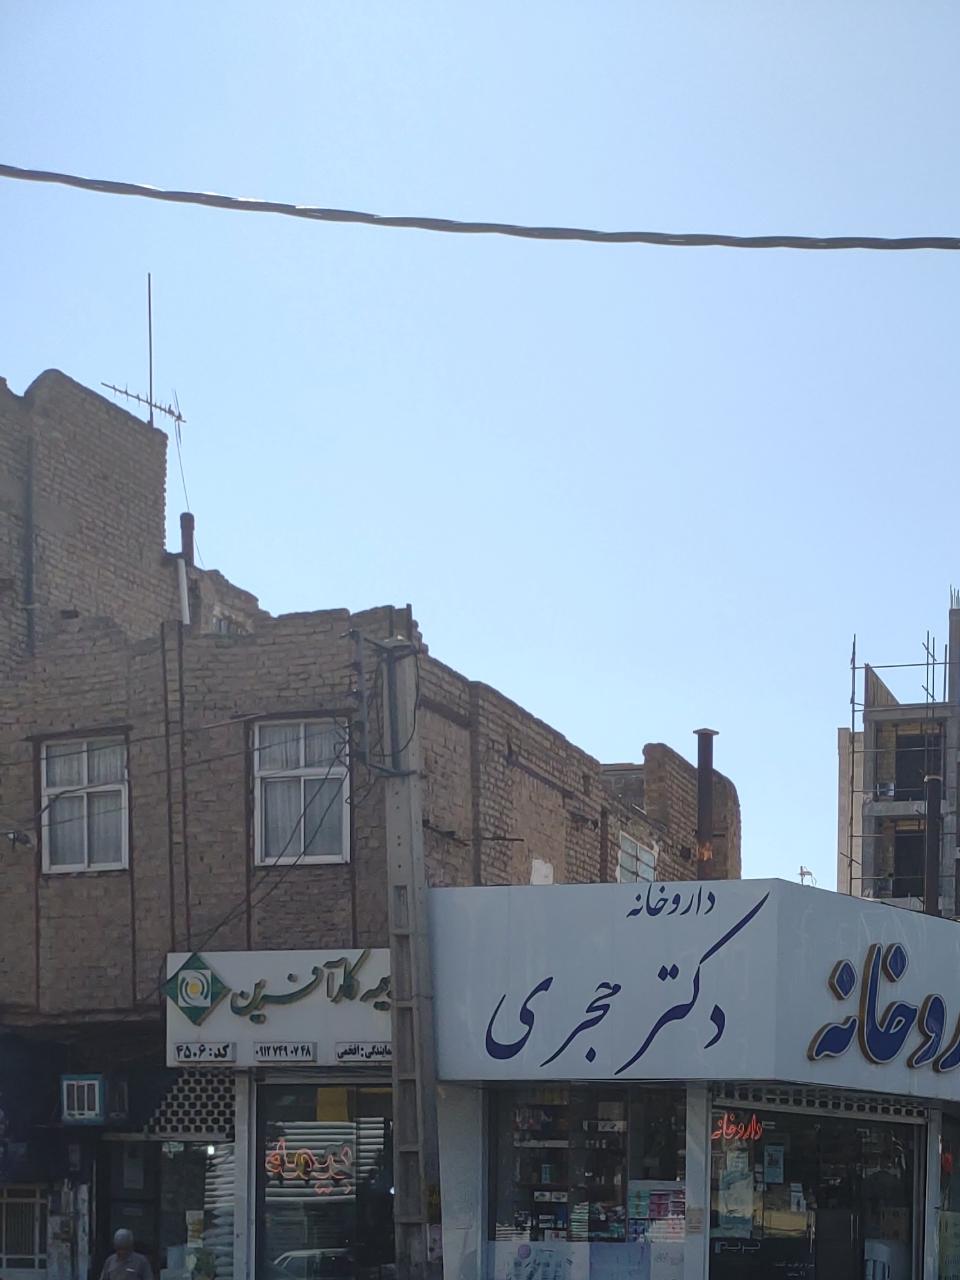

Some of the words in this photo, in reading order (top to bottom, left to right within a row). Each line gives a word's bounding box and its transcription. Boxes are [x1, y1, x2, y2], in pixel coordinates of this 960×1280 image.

[626, 884, 716, 918] داروخانه
[614, 891, 770, 1075] دکتر
[711, 1111, 763, 1141] داروخانه
